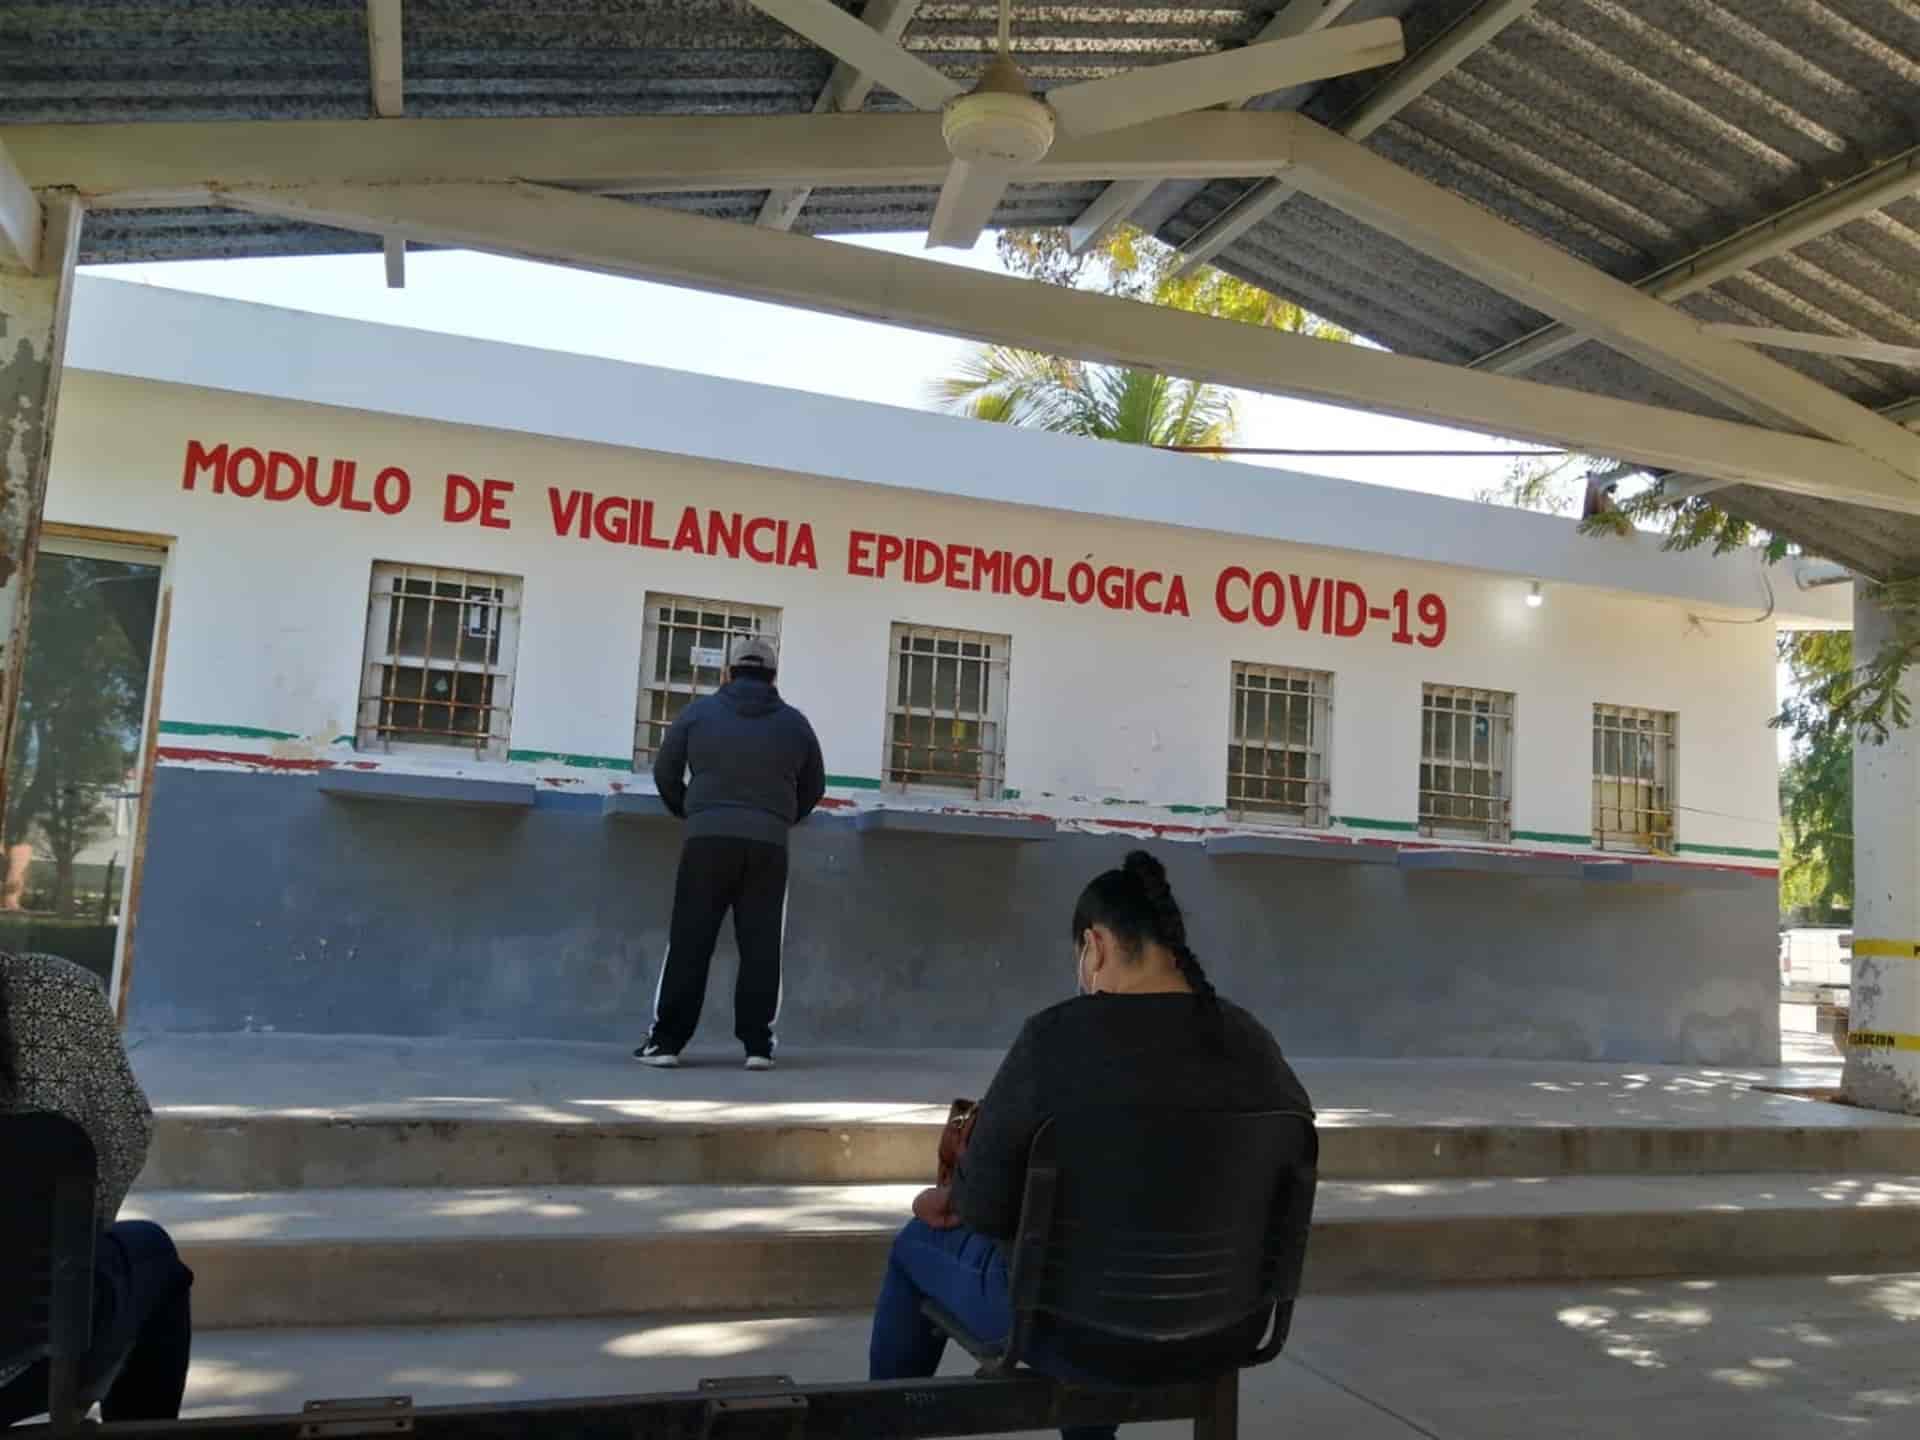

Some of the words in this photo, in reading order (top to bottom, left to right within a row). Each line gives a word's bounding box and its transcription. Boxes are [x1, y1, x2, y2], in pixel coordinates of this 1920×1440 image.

[184, 440, 411, 514] MODULO
[444, 474, 514, 529] DE
[548, 487, 818, 569] VIGILANCIA
[847, 531, 1190, 617] EPIDEMIOLÓGICA
[1215, 565, 1447, 648] COVID-19
